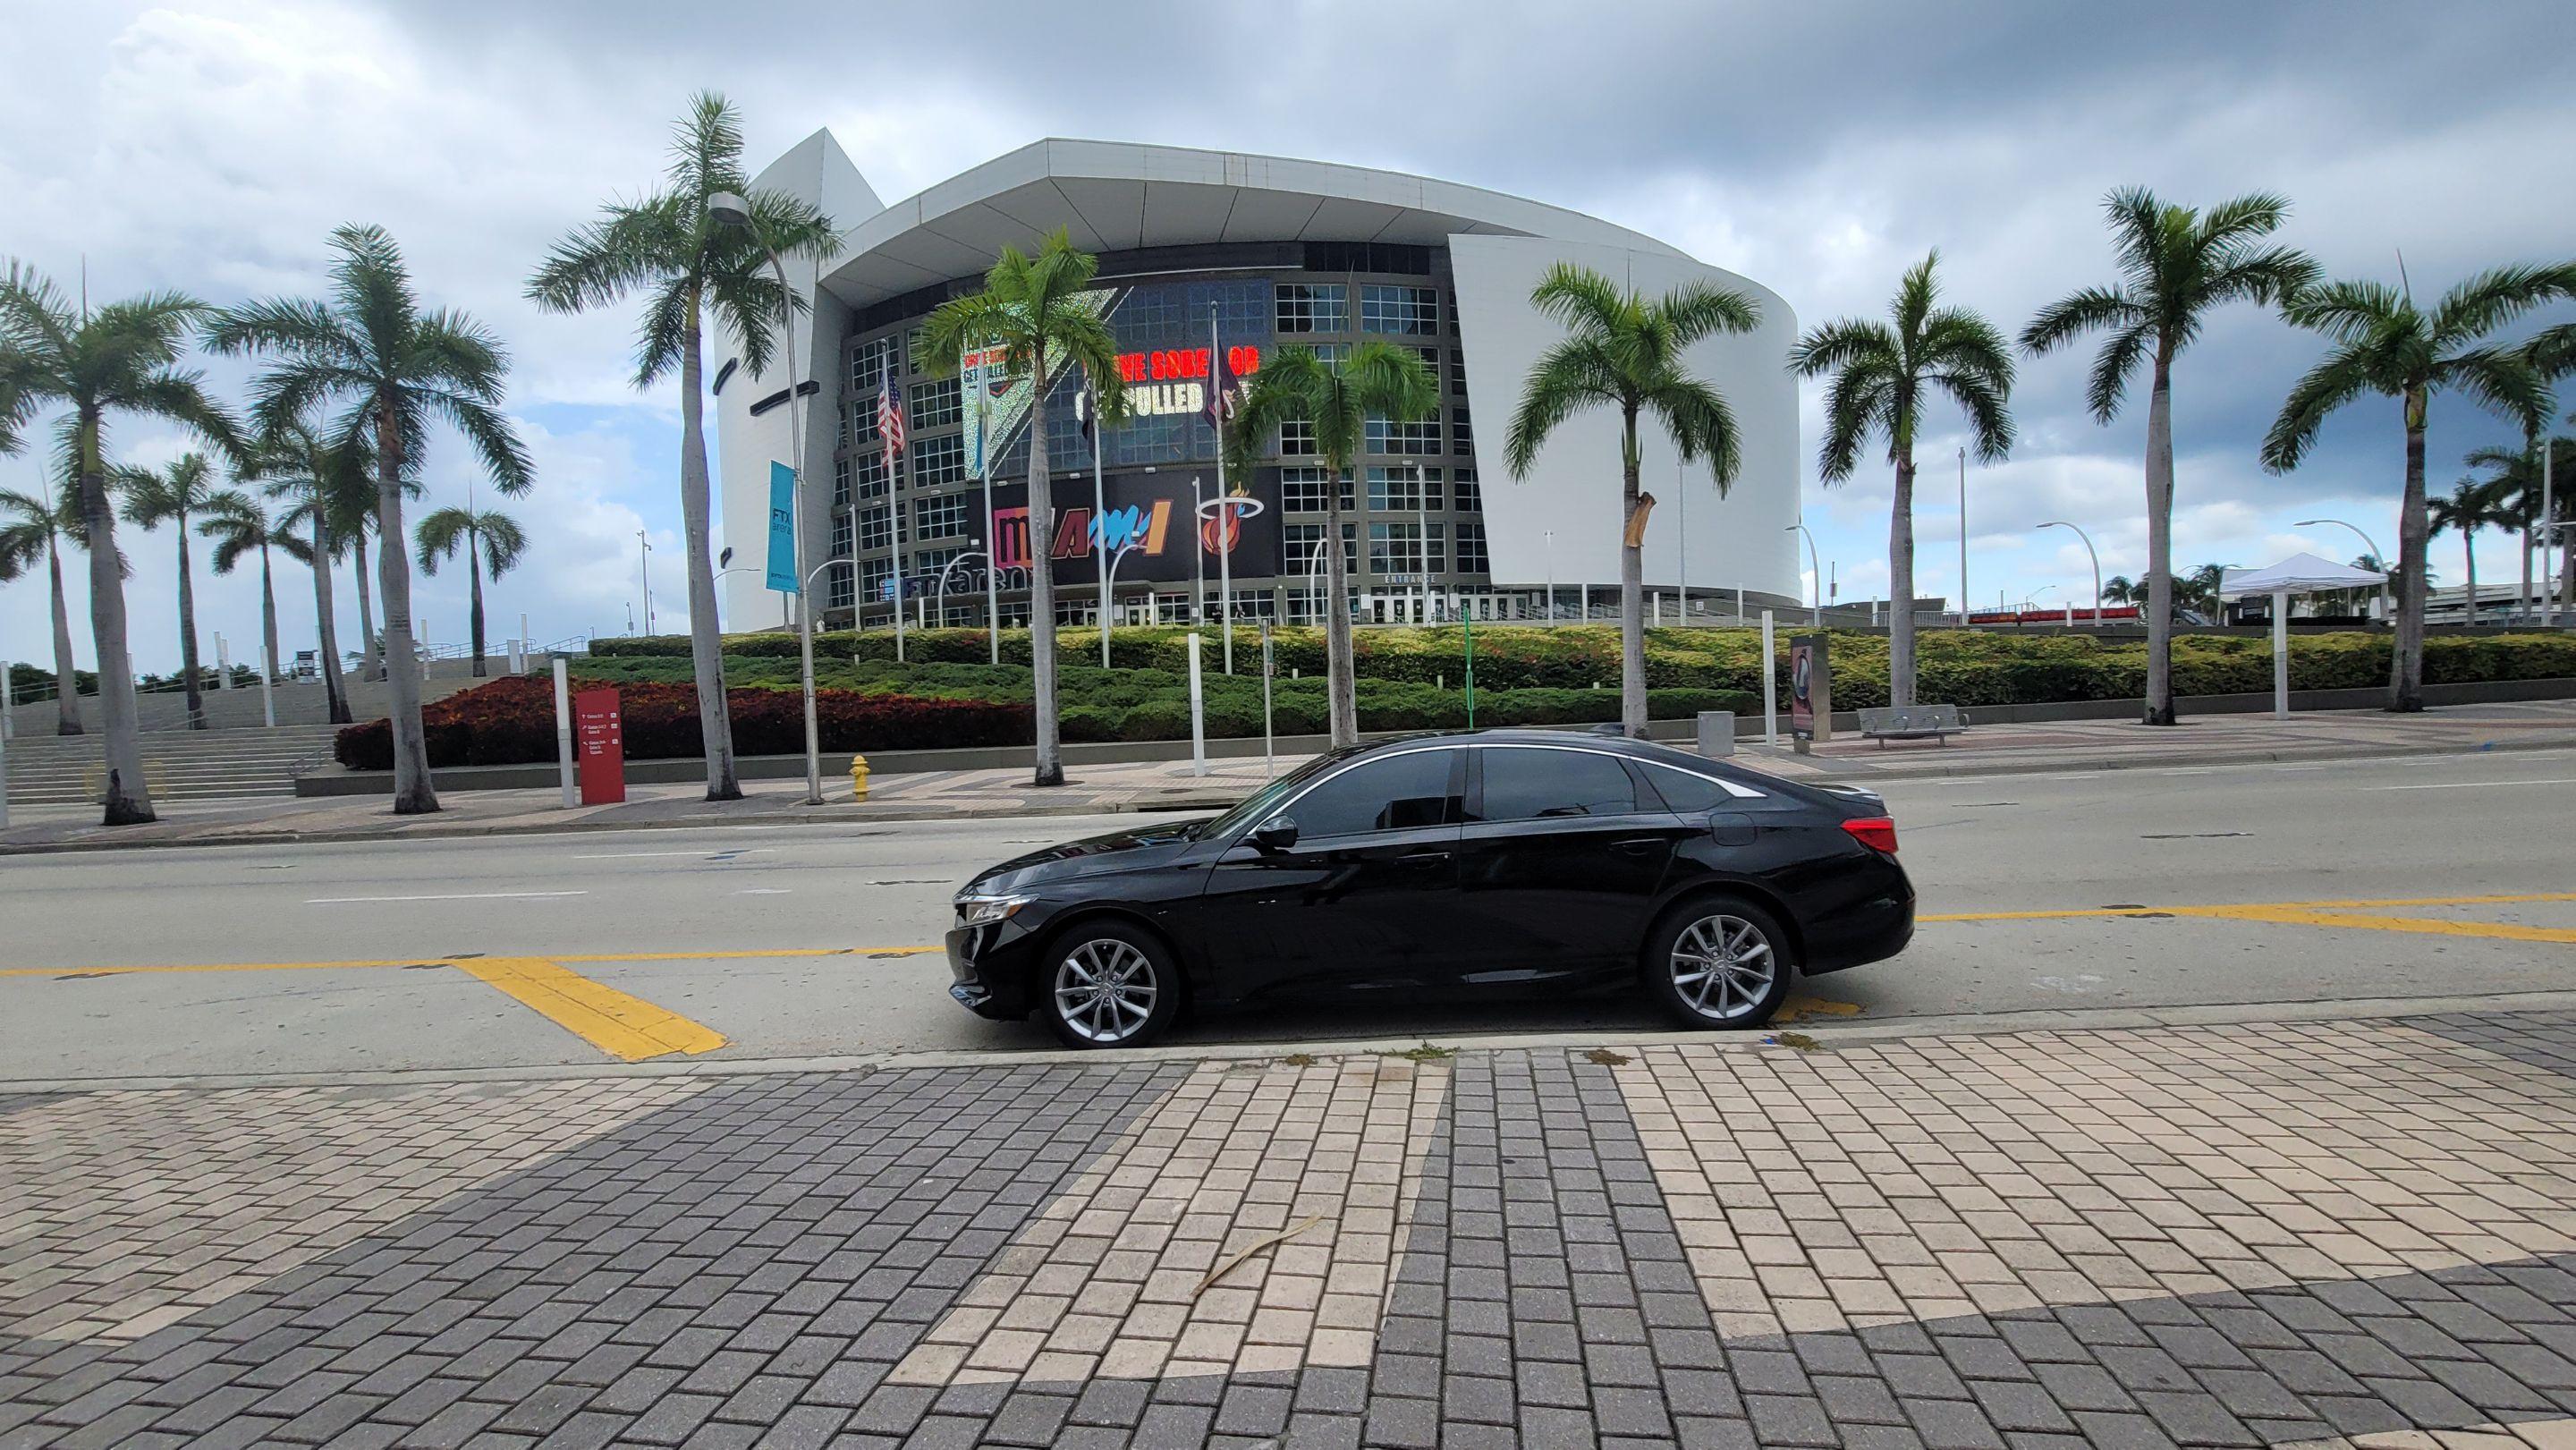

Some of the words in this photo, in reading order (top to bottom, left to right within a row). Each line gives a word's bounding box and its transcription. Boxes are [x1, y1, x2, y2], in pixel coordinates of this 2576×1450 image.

[1150, 348, 1210, 380] SOBE
[1228, 345, 1259, 376] OR
[773, 507, 791, 526] FTX
[994, 498, 1174, 569] MAMI
